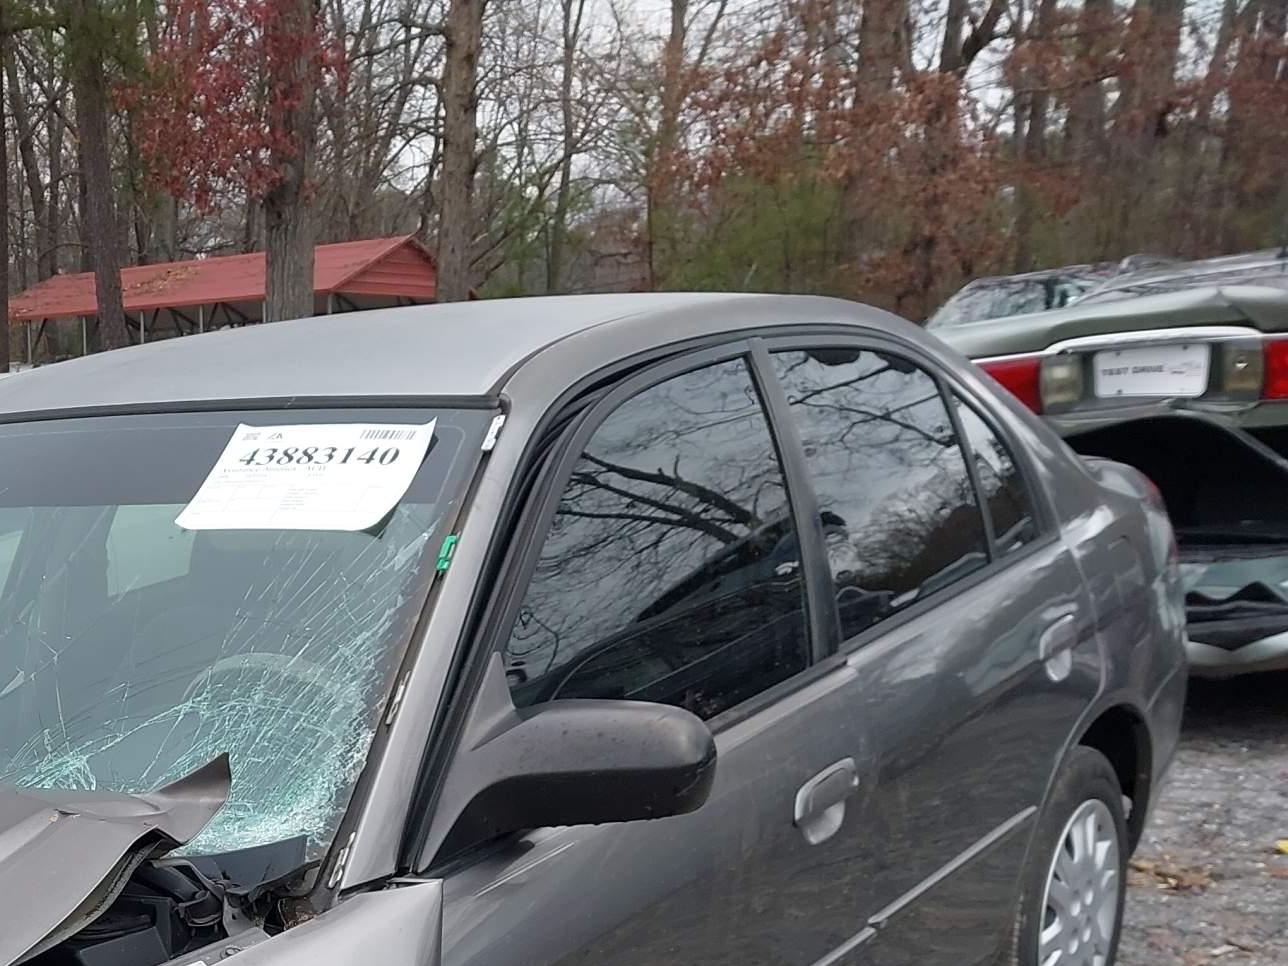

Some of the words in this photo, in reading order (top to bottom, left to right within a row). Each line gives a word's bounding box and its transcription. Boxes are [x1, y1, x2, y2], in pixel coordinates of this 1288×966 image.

[1101, 367, 1129, 377] TEST
[1132, 364, 1165, 375] DRIVE
[239, 446, 401, 466] 43883140
